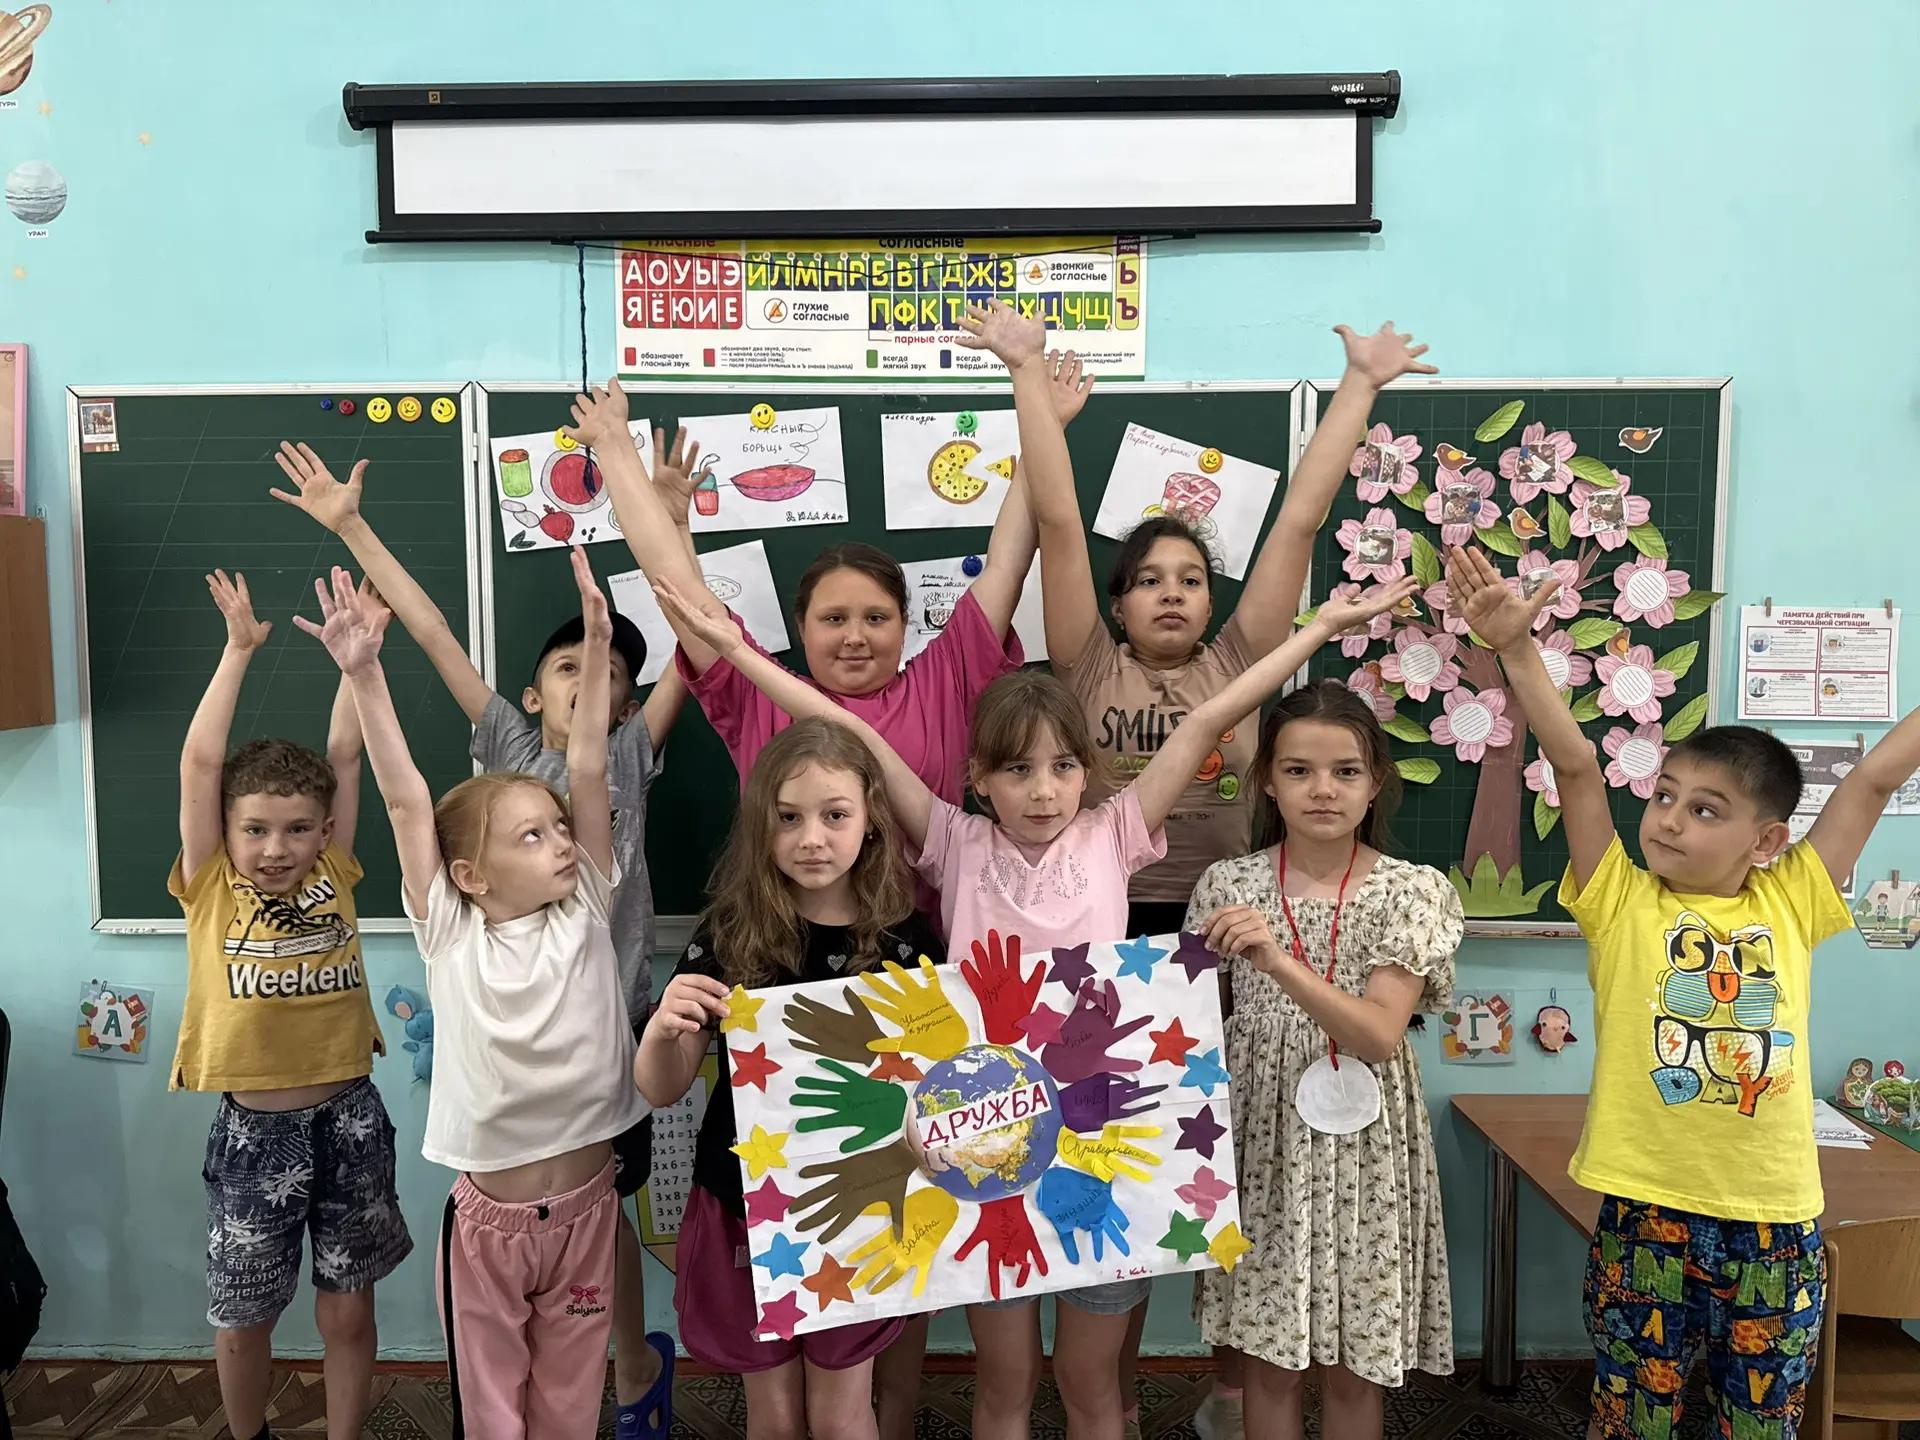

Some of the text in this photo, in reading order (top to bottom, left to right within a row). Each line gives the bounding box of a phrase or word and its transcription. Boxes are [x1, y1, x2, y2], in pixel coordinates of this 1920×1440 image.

[1050, 262, 1094, 271] звонкие
[1050, 272, 1107, 281] согласные
[792, 303, 829, 313] глухие
[792, 312, 850, 321] согласные
[894, 335, 935, 346] парные
[882, 355, 908, 363] всегда
[956, 355, 982, 363] всегда
[882, 362, 909, 370] мягкий
[226, 954, 362, 999] Weekend
[1650, 1065, 1773, 1118] DAY
[922, 1083, 1049, 1150] ДРУЖБА
[1116, 1268, 1125, 1280] 2
